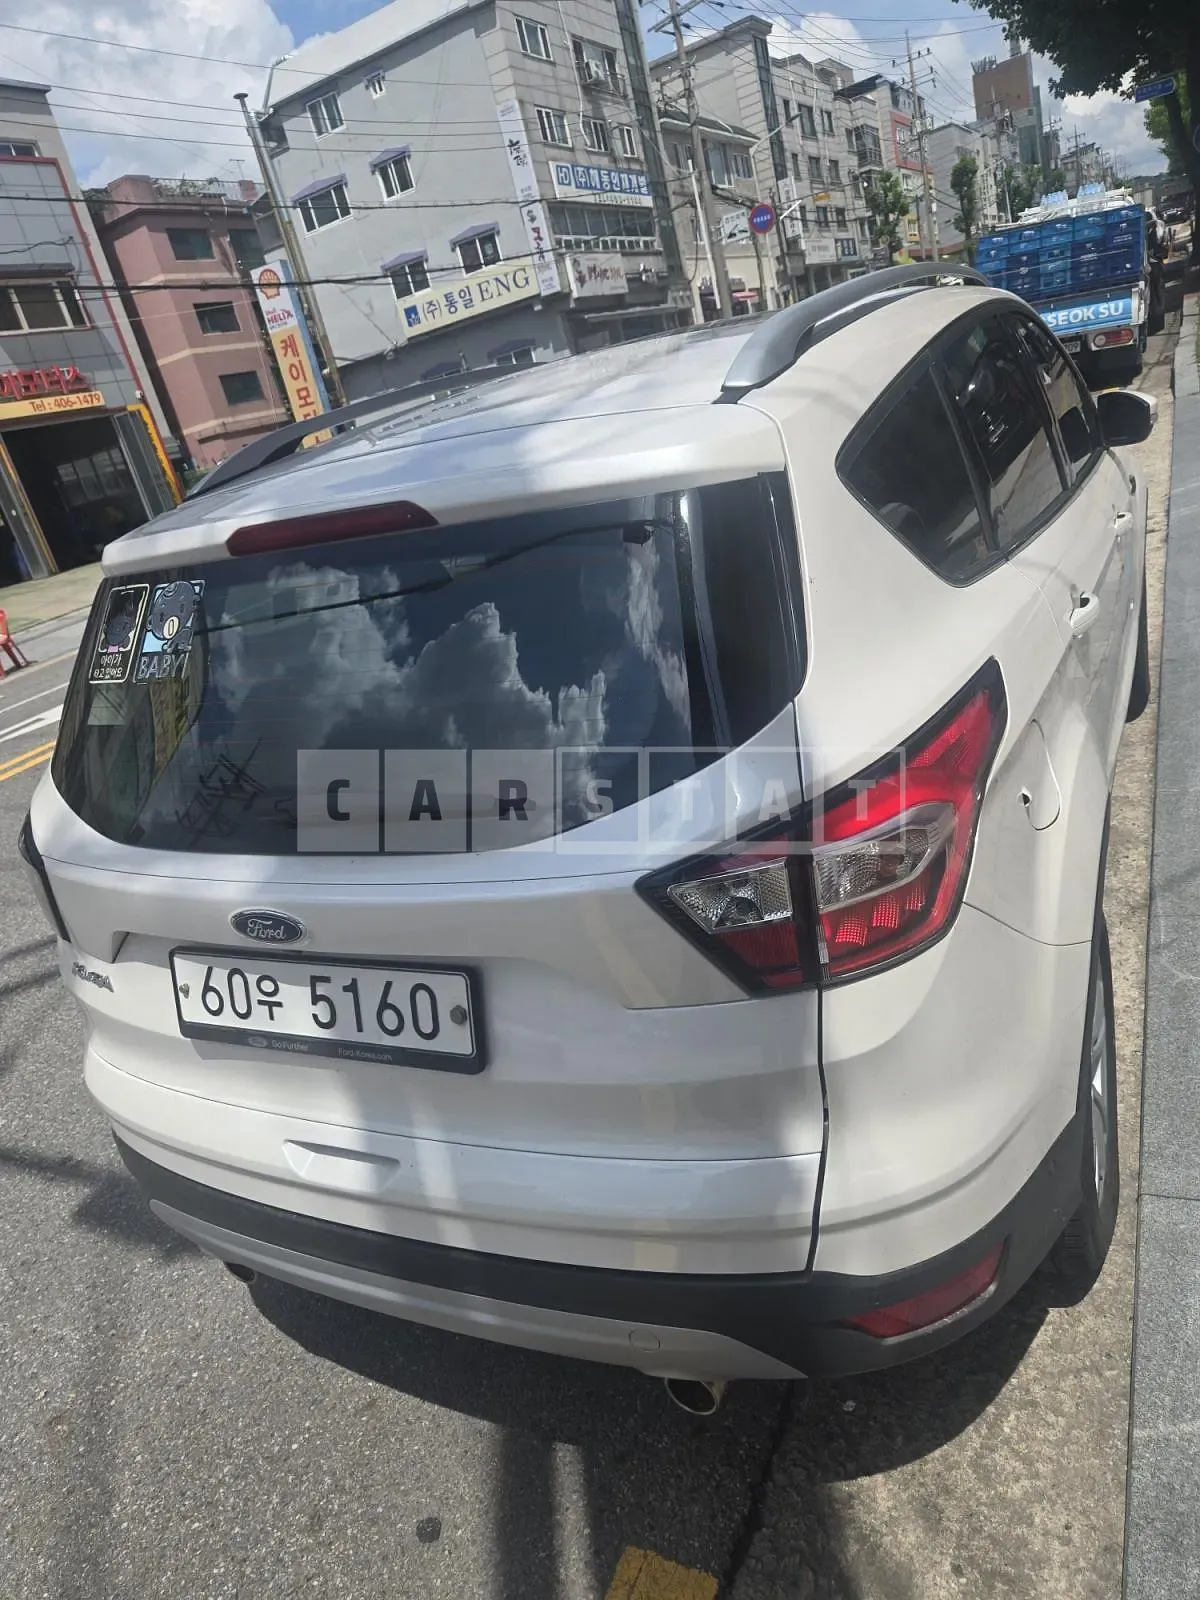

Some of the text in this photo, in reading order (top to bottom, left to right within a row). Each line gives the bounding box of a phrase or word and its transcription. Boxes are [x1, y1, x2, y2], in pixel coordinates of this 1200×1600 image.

[477, 267, 530, 302] ENG
[1047, 301, 1124, 328] SEOK SU
[54, 392, 101, 409] 406-1479
[100, 653, 122, 666] 아이가
[137, 653, 185, 680] BABY
[247, 918, 287, 940] Ford
[200, 965, 441, 1041] 60우 5160
